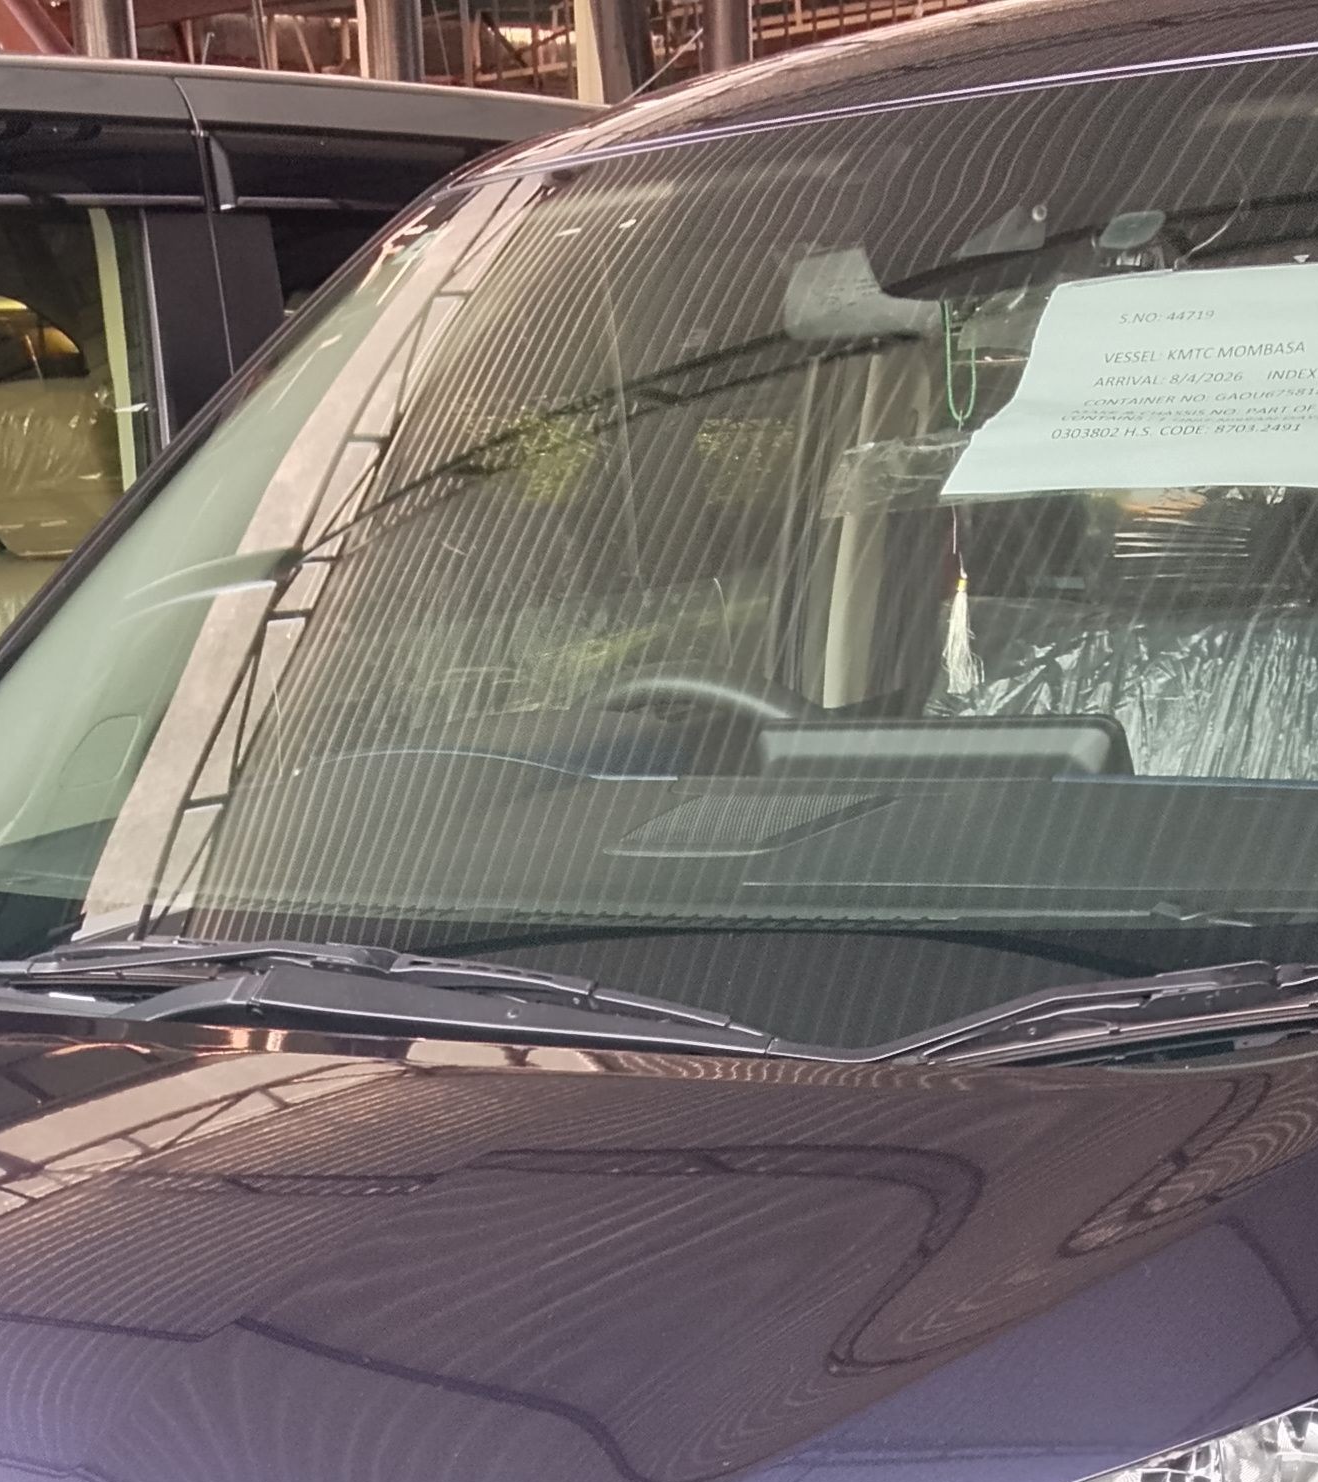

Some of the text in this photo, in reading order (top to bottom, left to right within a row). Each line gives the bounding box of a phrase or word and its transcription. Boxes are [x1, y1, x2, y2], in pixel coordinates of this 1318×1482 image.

[1167, 310, 1215, 321] 44719
[1167, 348, 1215, 361] KMTC
[1217, 341, 1306, 360] MOMBASA
[1094, 375, 1164, 388] ARRIVAL:
[1169, 371, 1244, 386] 8/4/2026
[1084, 395, 1175, 407] CONTAINER
[1051, 427, 1119, 440] 0303802
